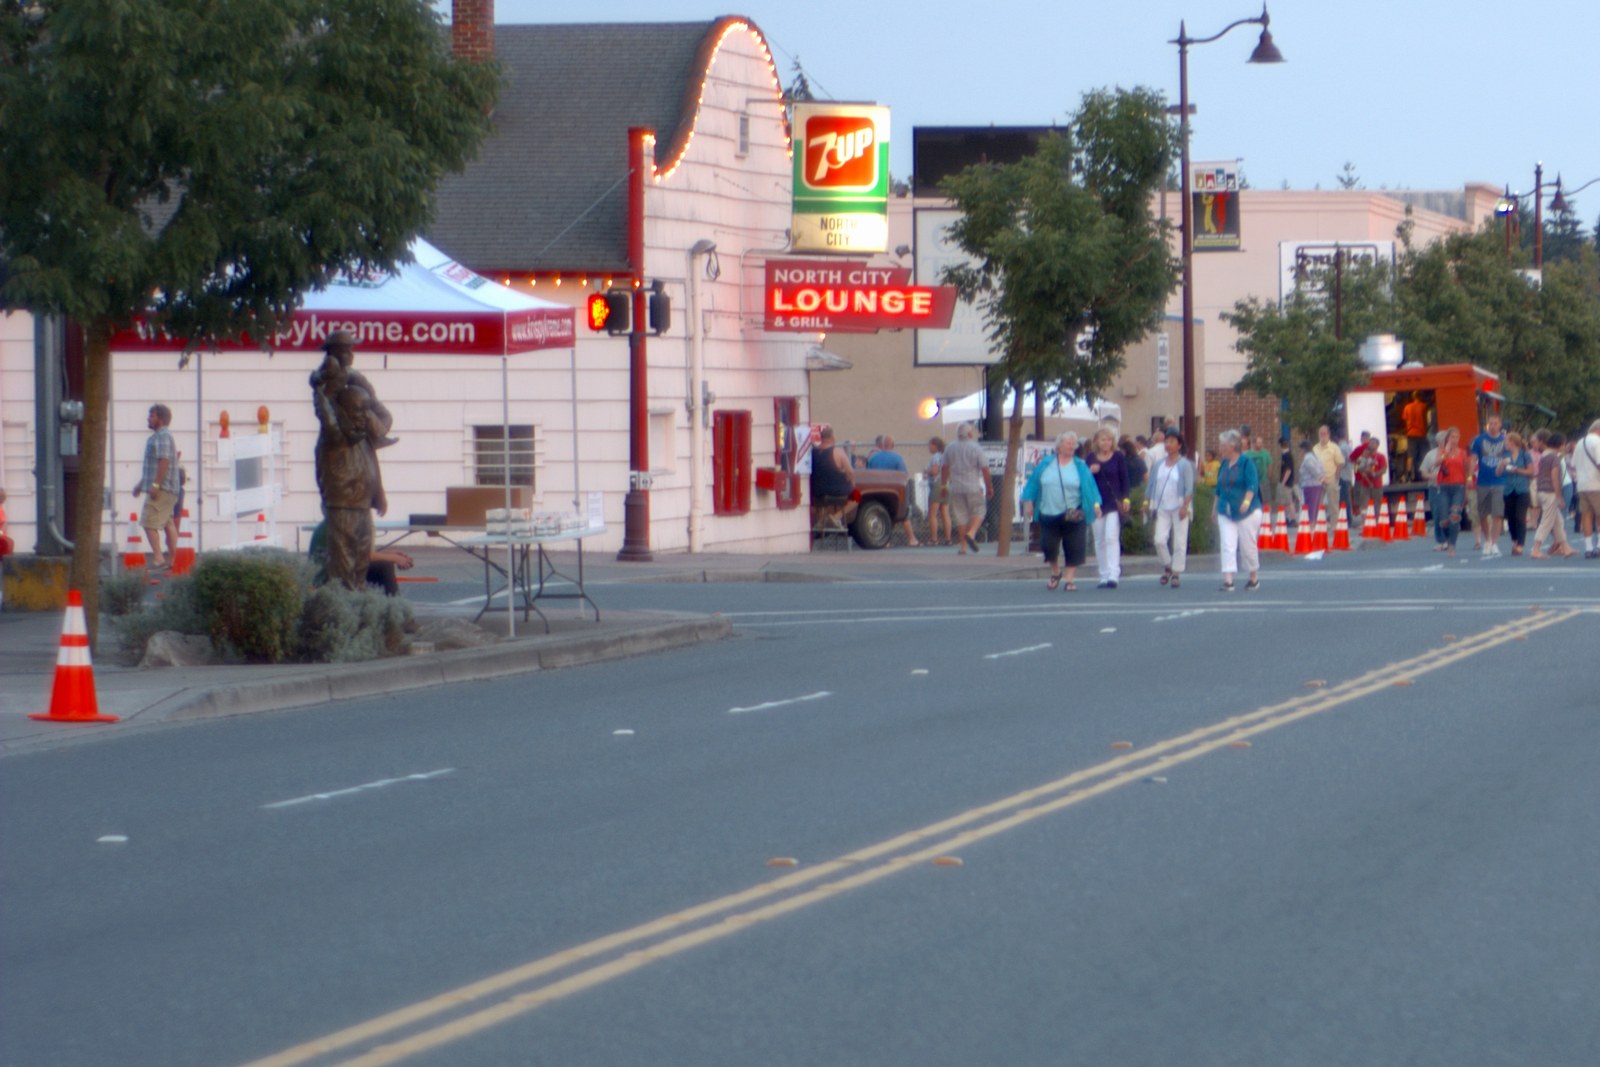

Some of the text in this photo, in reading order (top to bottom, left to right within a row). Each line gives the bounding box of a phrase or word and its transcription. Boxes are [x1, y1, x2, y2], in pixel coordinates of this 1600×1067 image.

[809, 128, 873, 178] 7UP
[826, 232, 850, 246] CITY
[773, 269, 892, 285] NORTH CITY
[772, 288, 933, 315] LOUNGE
[774, 316, 833, 329] & GRILL
